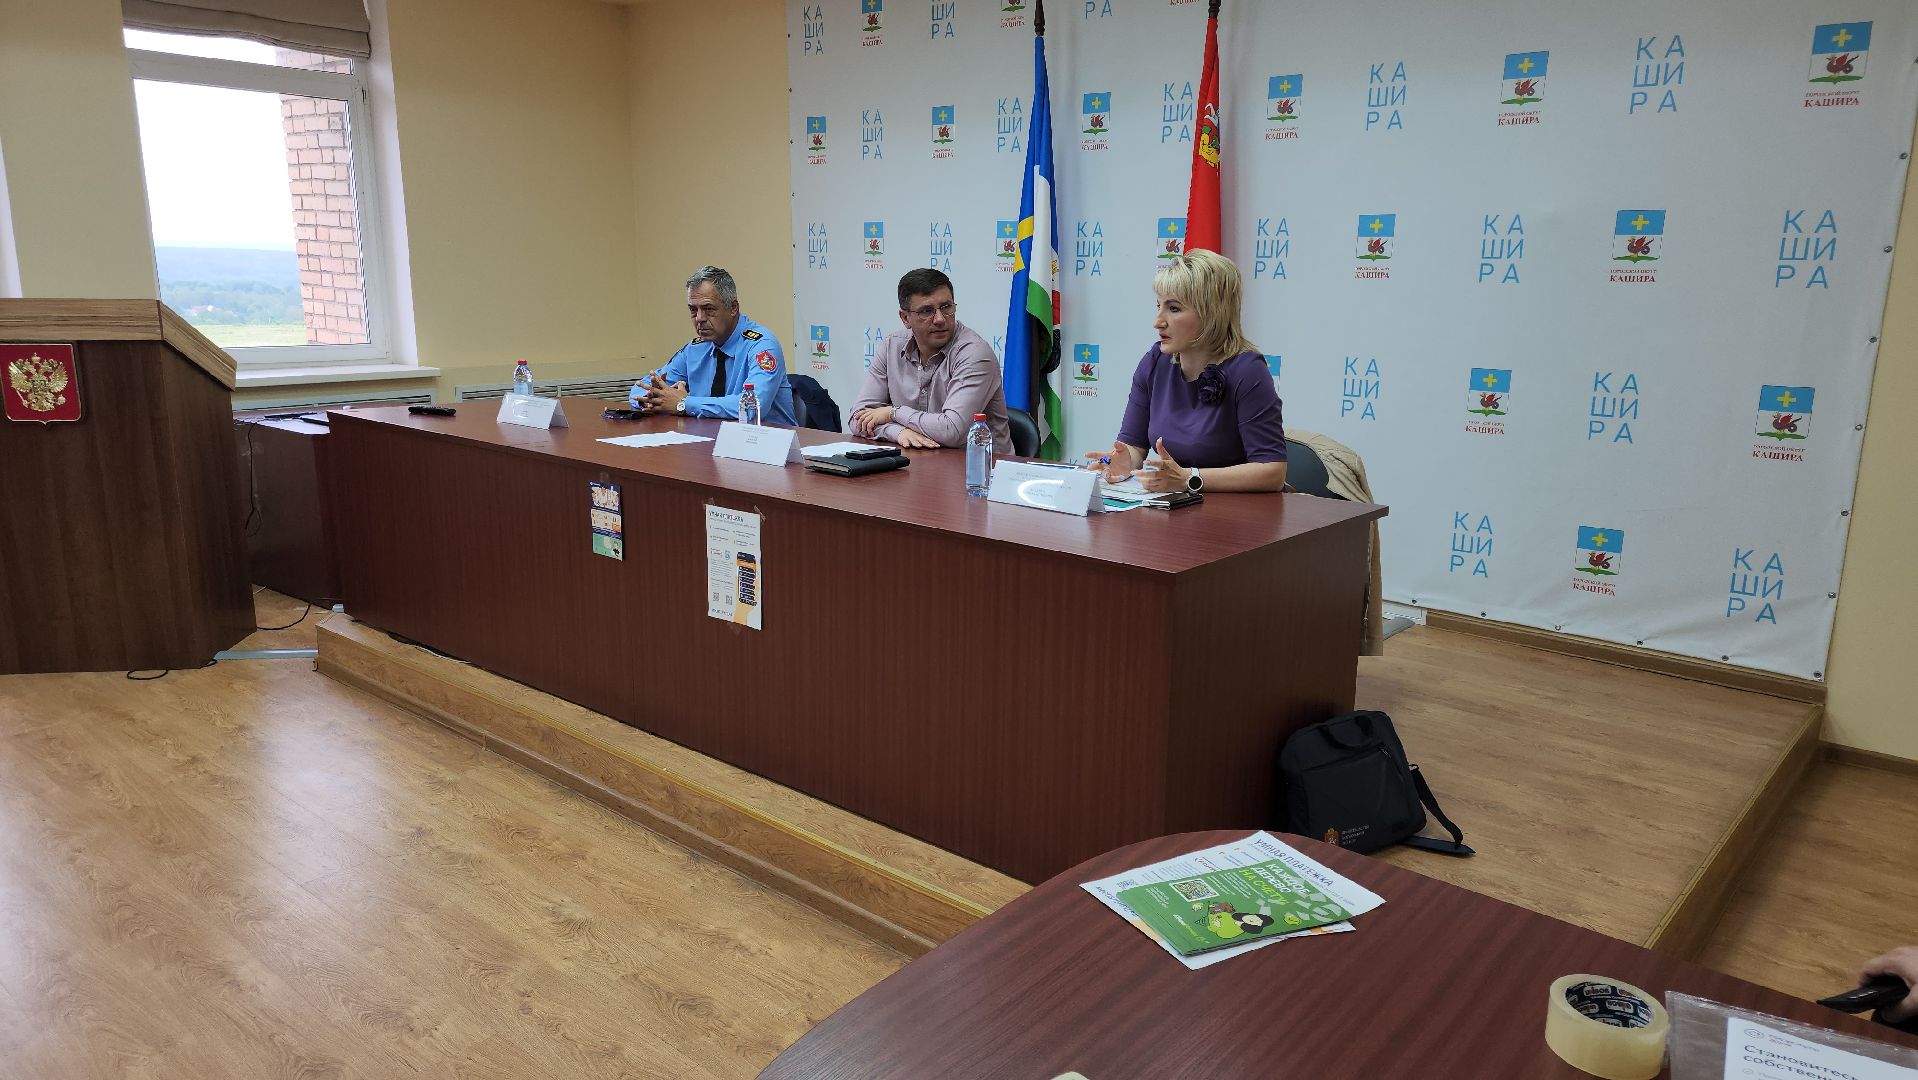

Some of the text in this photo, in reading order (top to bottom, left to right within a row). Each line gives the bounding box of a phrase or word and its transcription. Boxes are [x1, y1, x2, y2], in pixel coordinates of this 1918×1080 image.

[1804, 96, 1860, 108] КАШИРА
[1497, 116, 1540, 126] КАШИРА
[1610, 274, 1656, 283] КАШИРА
[1465, 425, 1505, 436] КАШИРА
[1752, 450, 1803, 462] КАШИРА
[1572, 582, 1616, 597] КАШИРА
[1254, 838, 1286, 858] УМНАЯ
[1239, 869, 1257, 881] НА
[1250, 867, 1292, 893] ДЕРЕВО
[1266, 863, 1312, 895] КАЖДОЕ
